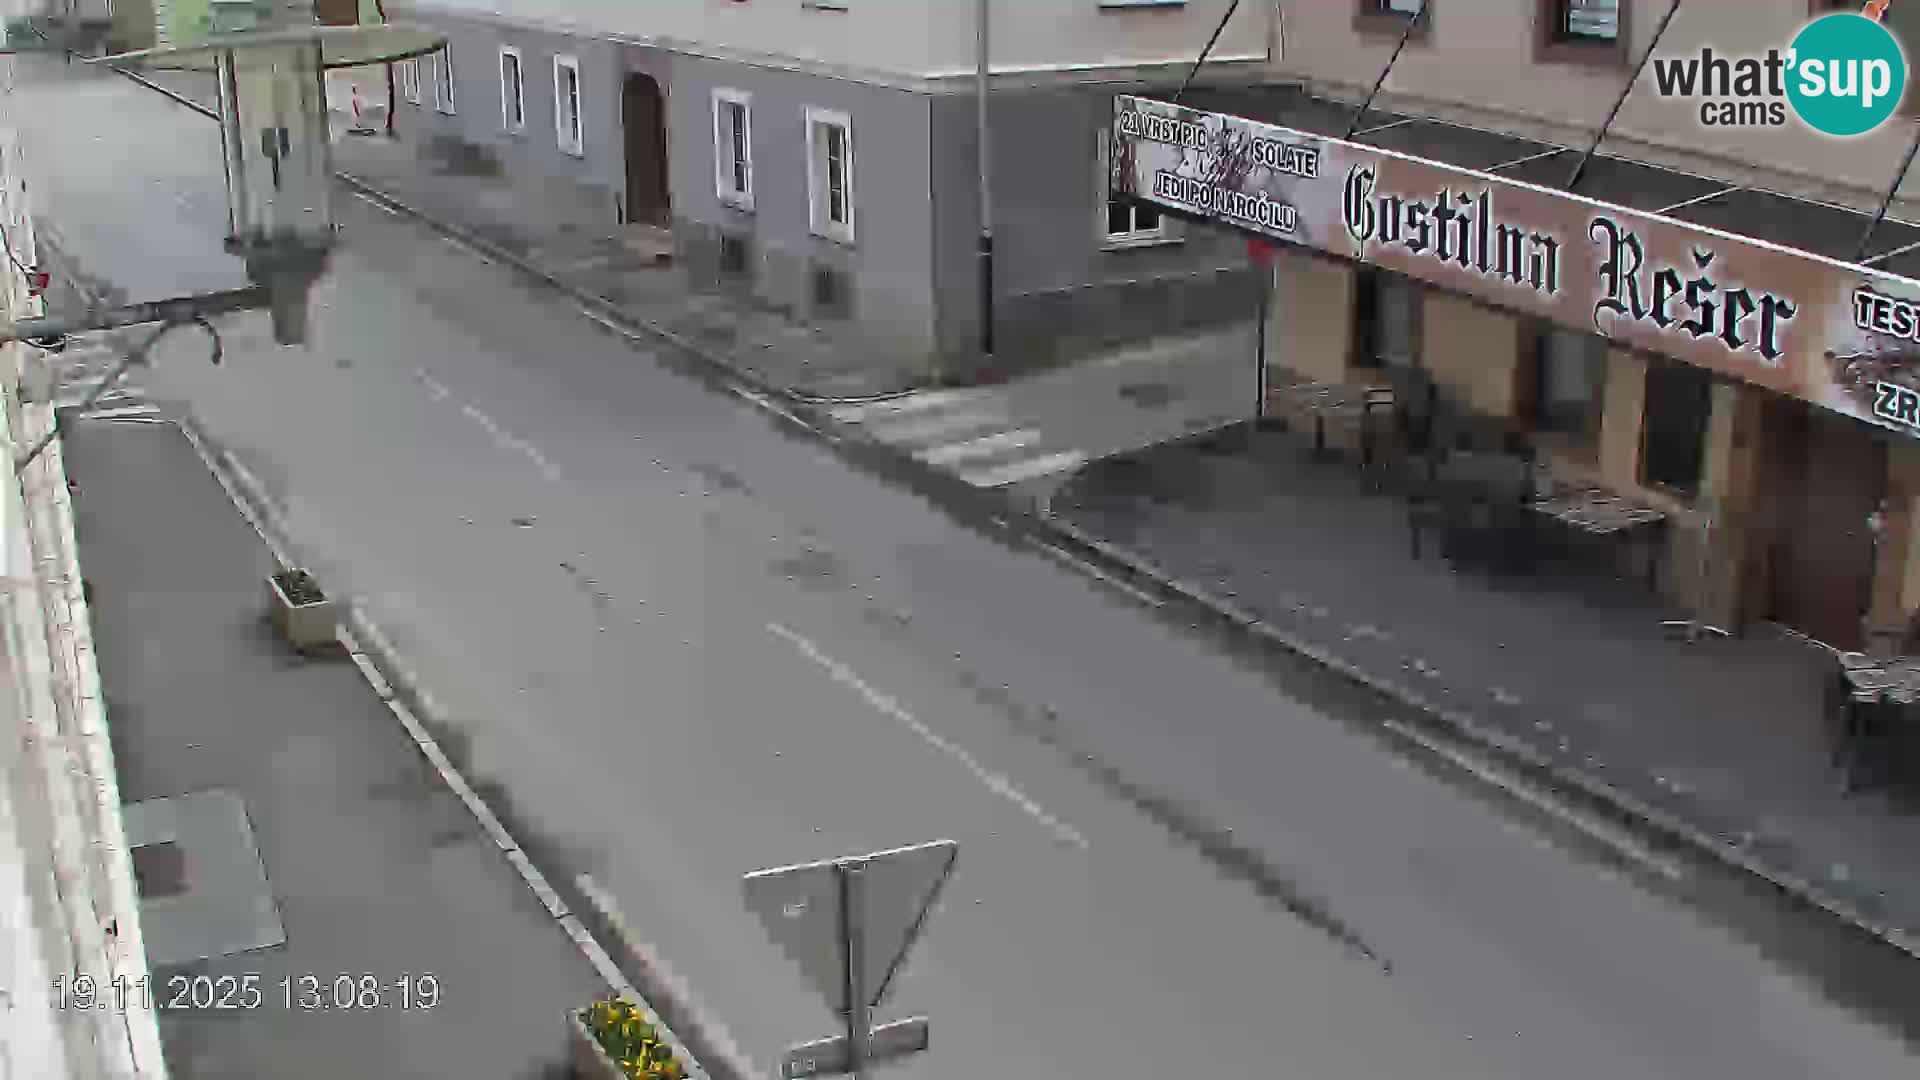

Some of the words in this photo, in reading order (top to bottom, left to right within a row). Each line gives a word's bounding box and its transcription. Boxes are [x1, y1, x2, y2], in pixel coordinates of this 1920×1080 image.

[1120, 111, 1140, 136] 21
[1252, 139, 1318, 177] SOLATE
[1343, 162, 1561, 297] Gostilna
[1588, 214, 1797, 359] Rešer
[1873, 381, 1920, 428] ZR
